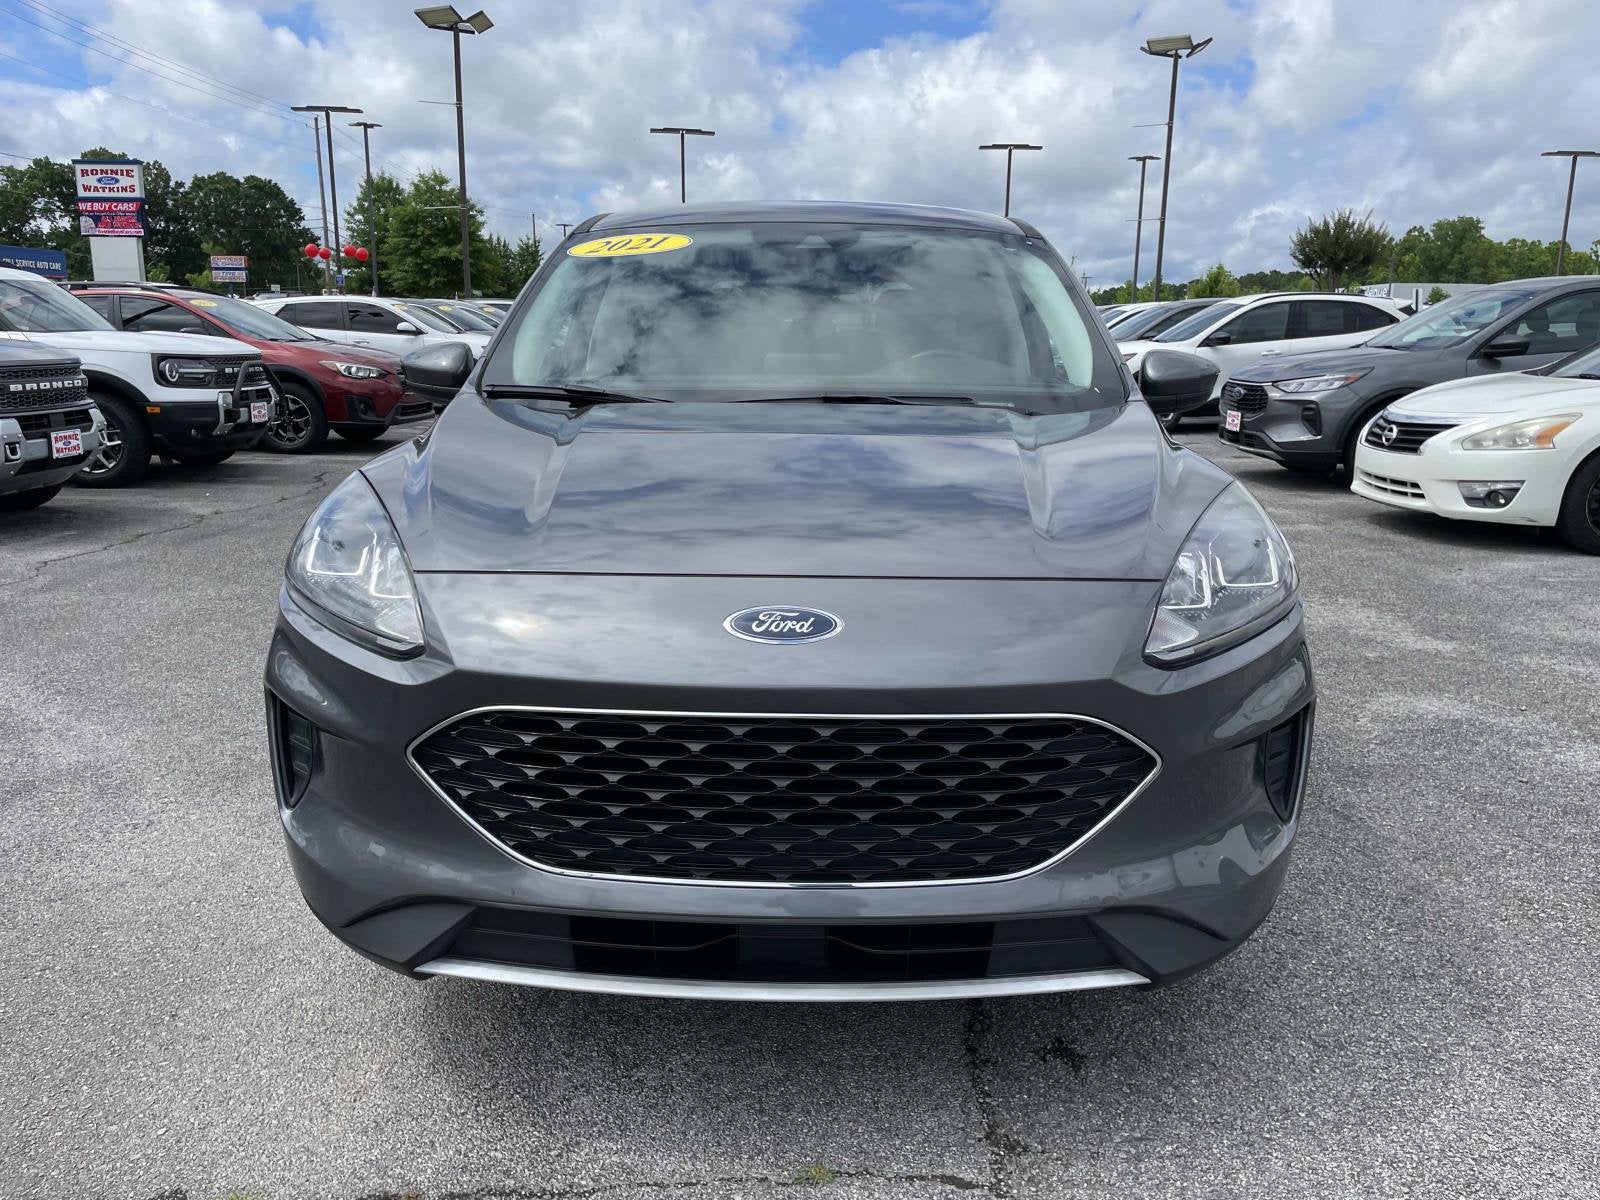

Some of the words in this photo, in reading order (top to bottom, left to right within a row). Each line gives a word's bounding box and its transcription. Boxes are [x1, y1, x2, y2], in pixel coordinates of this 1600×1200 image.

[80, 168, 134, 178] RONNIE
[81, 184, 136, 193] WATKINS
[78, 202, 92, 211] WE
[93, 202, 111, 211] BUY
[111, 203, 137, 211] CARS!
[585, 236, 671, 254] 2021
[15, 259, 36, 269] SERVICE
[36, 261, 49, 269] AUTO
[49, 262, 62, 271] CARE
[9, 379, 82, 392] BRONCO
[53, 433, 79, 444] RONNIE
[54, 444, 81, 454] WATKINS
[751, 611, 815, 633] Ford
